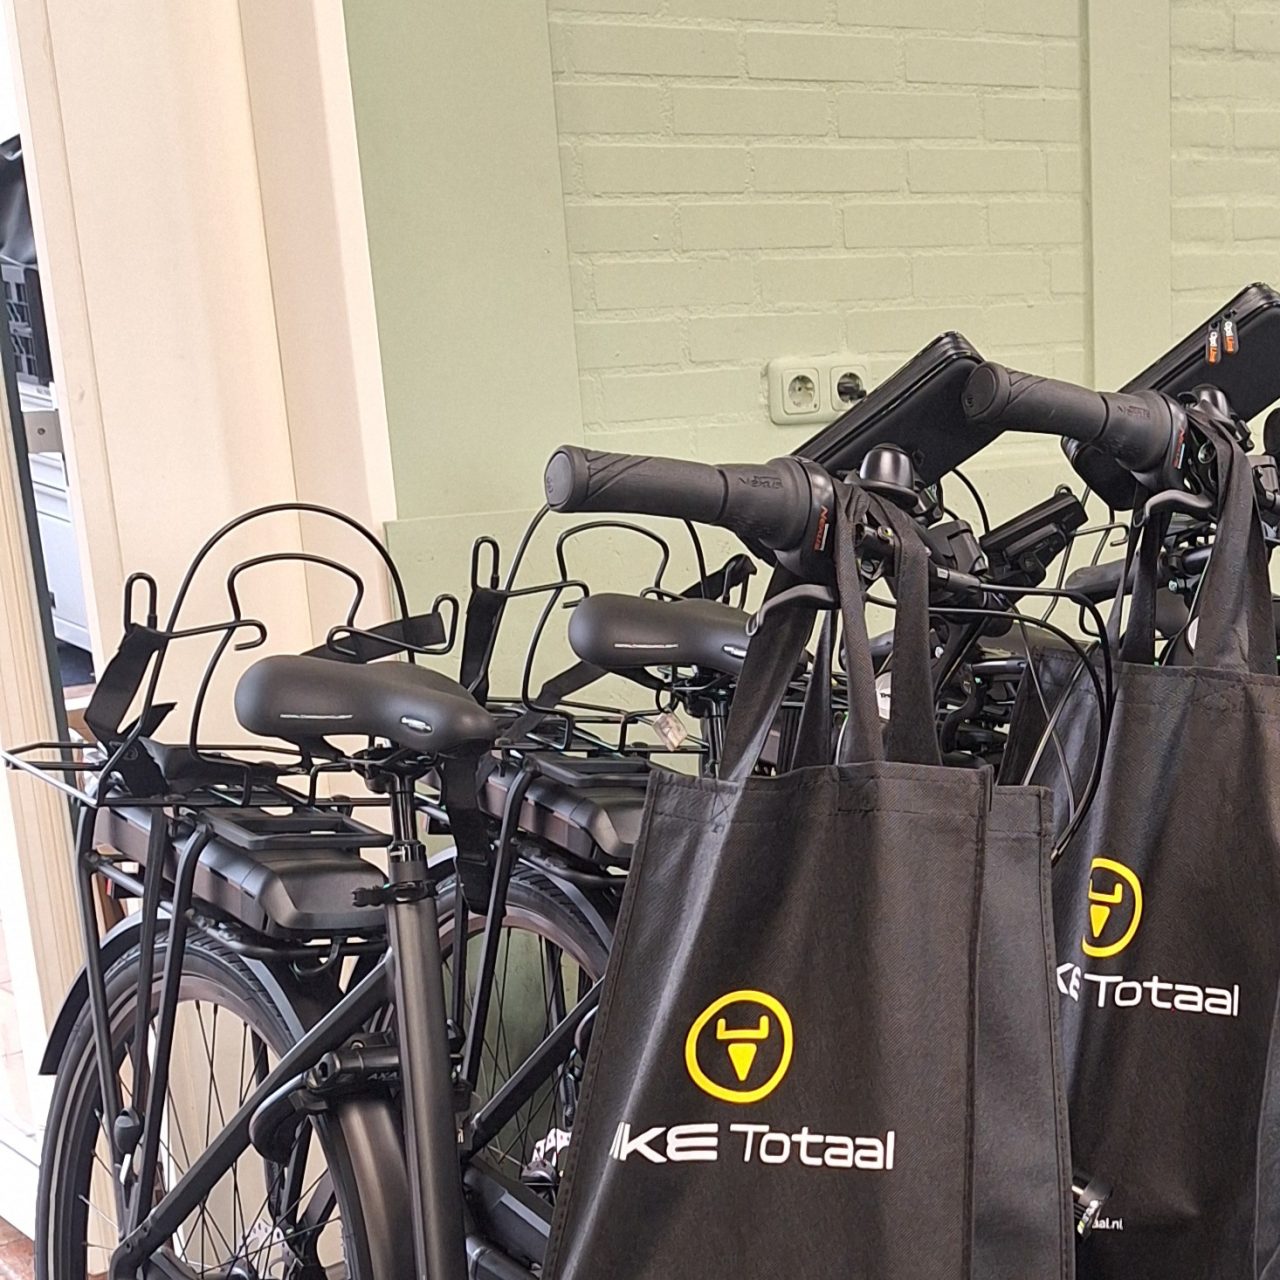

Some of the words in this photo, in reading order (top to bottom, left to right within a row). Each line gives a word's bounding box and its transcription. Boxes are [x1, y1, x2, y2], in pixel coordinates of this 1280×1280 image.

[1056, 962, 1082, 1001] KE
[1084, 973, 1240, 1017] Totaal
[609, 1121, 719, 1164] IKE
[730, 1123, 896, 1170] Totaal
